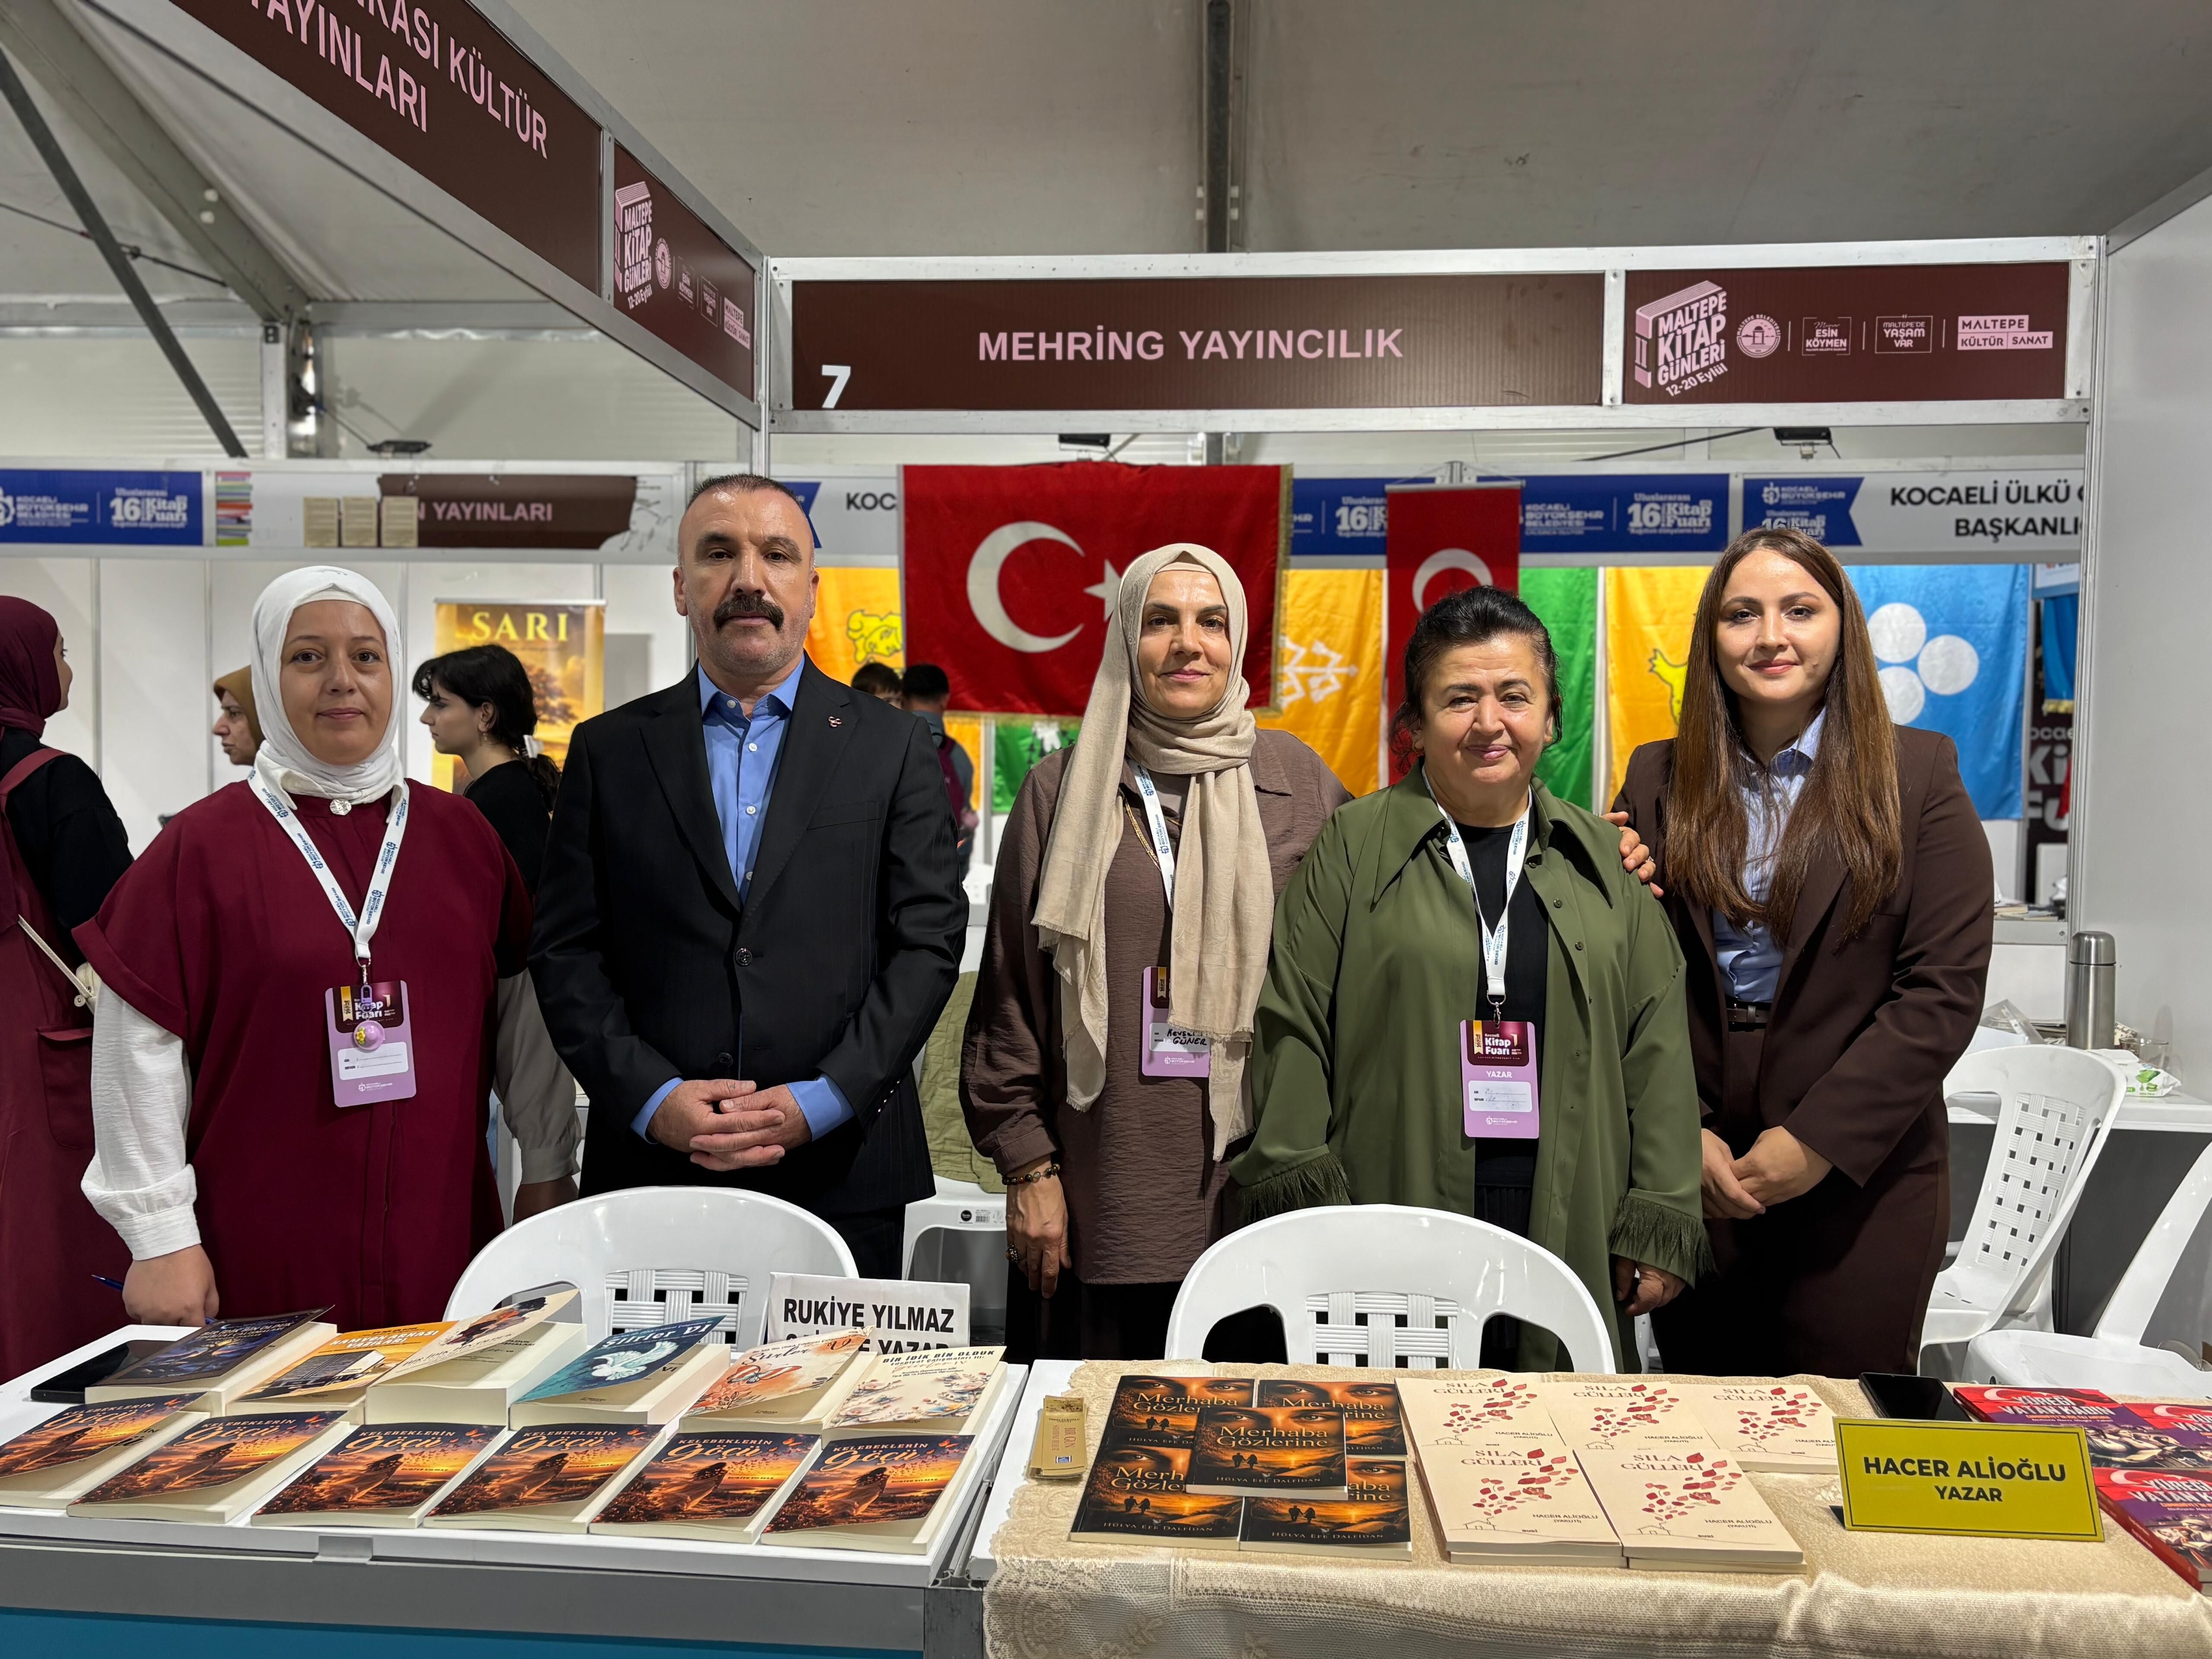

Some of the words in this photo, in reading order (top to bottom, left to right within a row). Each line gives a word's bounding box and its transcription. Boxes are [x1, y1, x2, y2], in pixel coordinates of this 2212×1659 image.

[450, 37, 547, 159] KÜLTÜR
[625, 200, 652, 232] MALTEPE
[625, 224, 652, 268] KİTAP
[624, 256, 652, 293] GÜNLERİ
[1658, 291, 1727, 336] MALTEPE
[1815, 327, 1838, 337] ESİN
[1962, 319, 2025, 330] MALTEPE
[979, 325, 1165, 361] MEHRİNG
[1179, 328, 1403, 359] YAYINCILIK
[1658, 313, 1726, 366] KİTAP
[1806, 337, 1847, 347] KÖYMEN
[1894, 339, 1913, 347] VAR
[1961, 336, 2004, 346] KÜLTÜR
[2012, 336, 2048, 345] SANAT
[1658, 339, 1725, 385] GÜNLERİ
[821, 365, 851, 408] 7
[1665, 376, 1698, 397] 12-20
[1696, 363, 1728, 386] Eylül
[1891, 480, 1998, 506] KOCAELİ
[2005, 480, 2070, 503] ÜLKÜ
[110, 497, 140, 522] 16
[432, 502, 553, 521] YAYINLARI
[1335, 506, 1368, 531] 16
[1628, 503, 1661, 528] 16
[1666, 501, 1712, 518] Kitap
[1955, 517, 2083, 542] BAŞKANLI
[472, 612, 568, 641] SARI
[1485, 1037, 1511, 1047] Kitap
[1485, 1046, 1510, 1055] Fuarı
[784, 1296, 864, 1327] RUKİYE
[872, 1304, 954, 1333] YILMAZ
[1138, 1392, 1237, 1406] Merhaba
[1998, 1406, 2062, 1415] VATAN
[2060, 1406, 2116, 1415] KADIN
[1217, 1436, 1327, 1448] Gözlerine
[1220, 1426, 1327, 1438] Merhaba
[338, 1435, 443, 1456] Göçü
[504, 1436, 606, 1456] Göçü
[661, 1443, 762, 1463] Göçü
[833, 1443, 928, 1452] KELEBEKLERİN
[820, 1449, 920, 1471] Göçü
[1461, 1458, 1542, 1466] GÜLLERİ
[1621, 1463, 1703, 1471] GÜLLERİ
[1863, 1456, 1950, 1478] HACER
[1957, 1456, 2066, 1481] ALİOĞLU
[1934, 1485, 2003, 1502] YAZAR
[2127, 1491, 2201, 1502] VATAN
